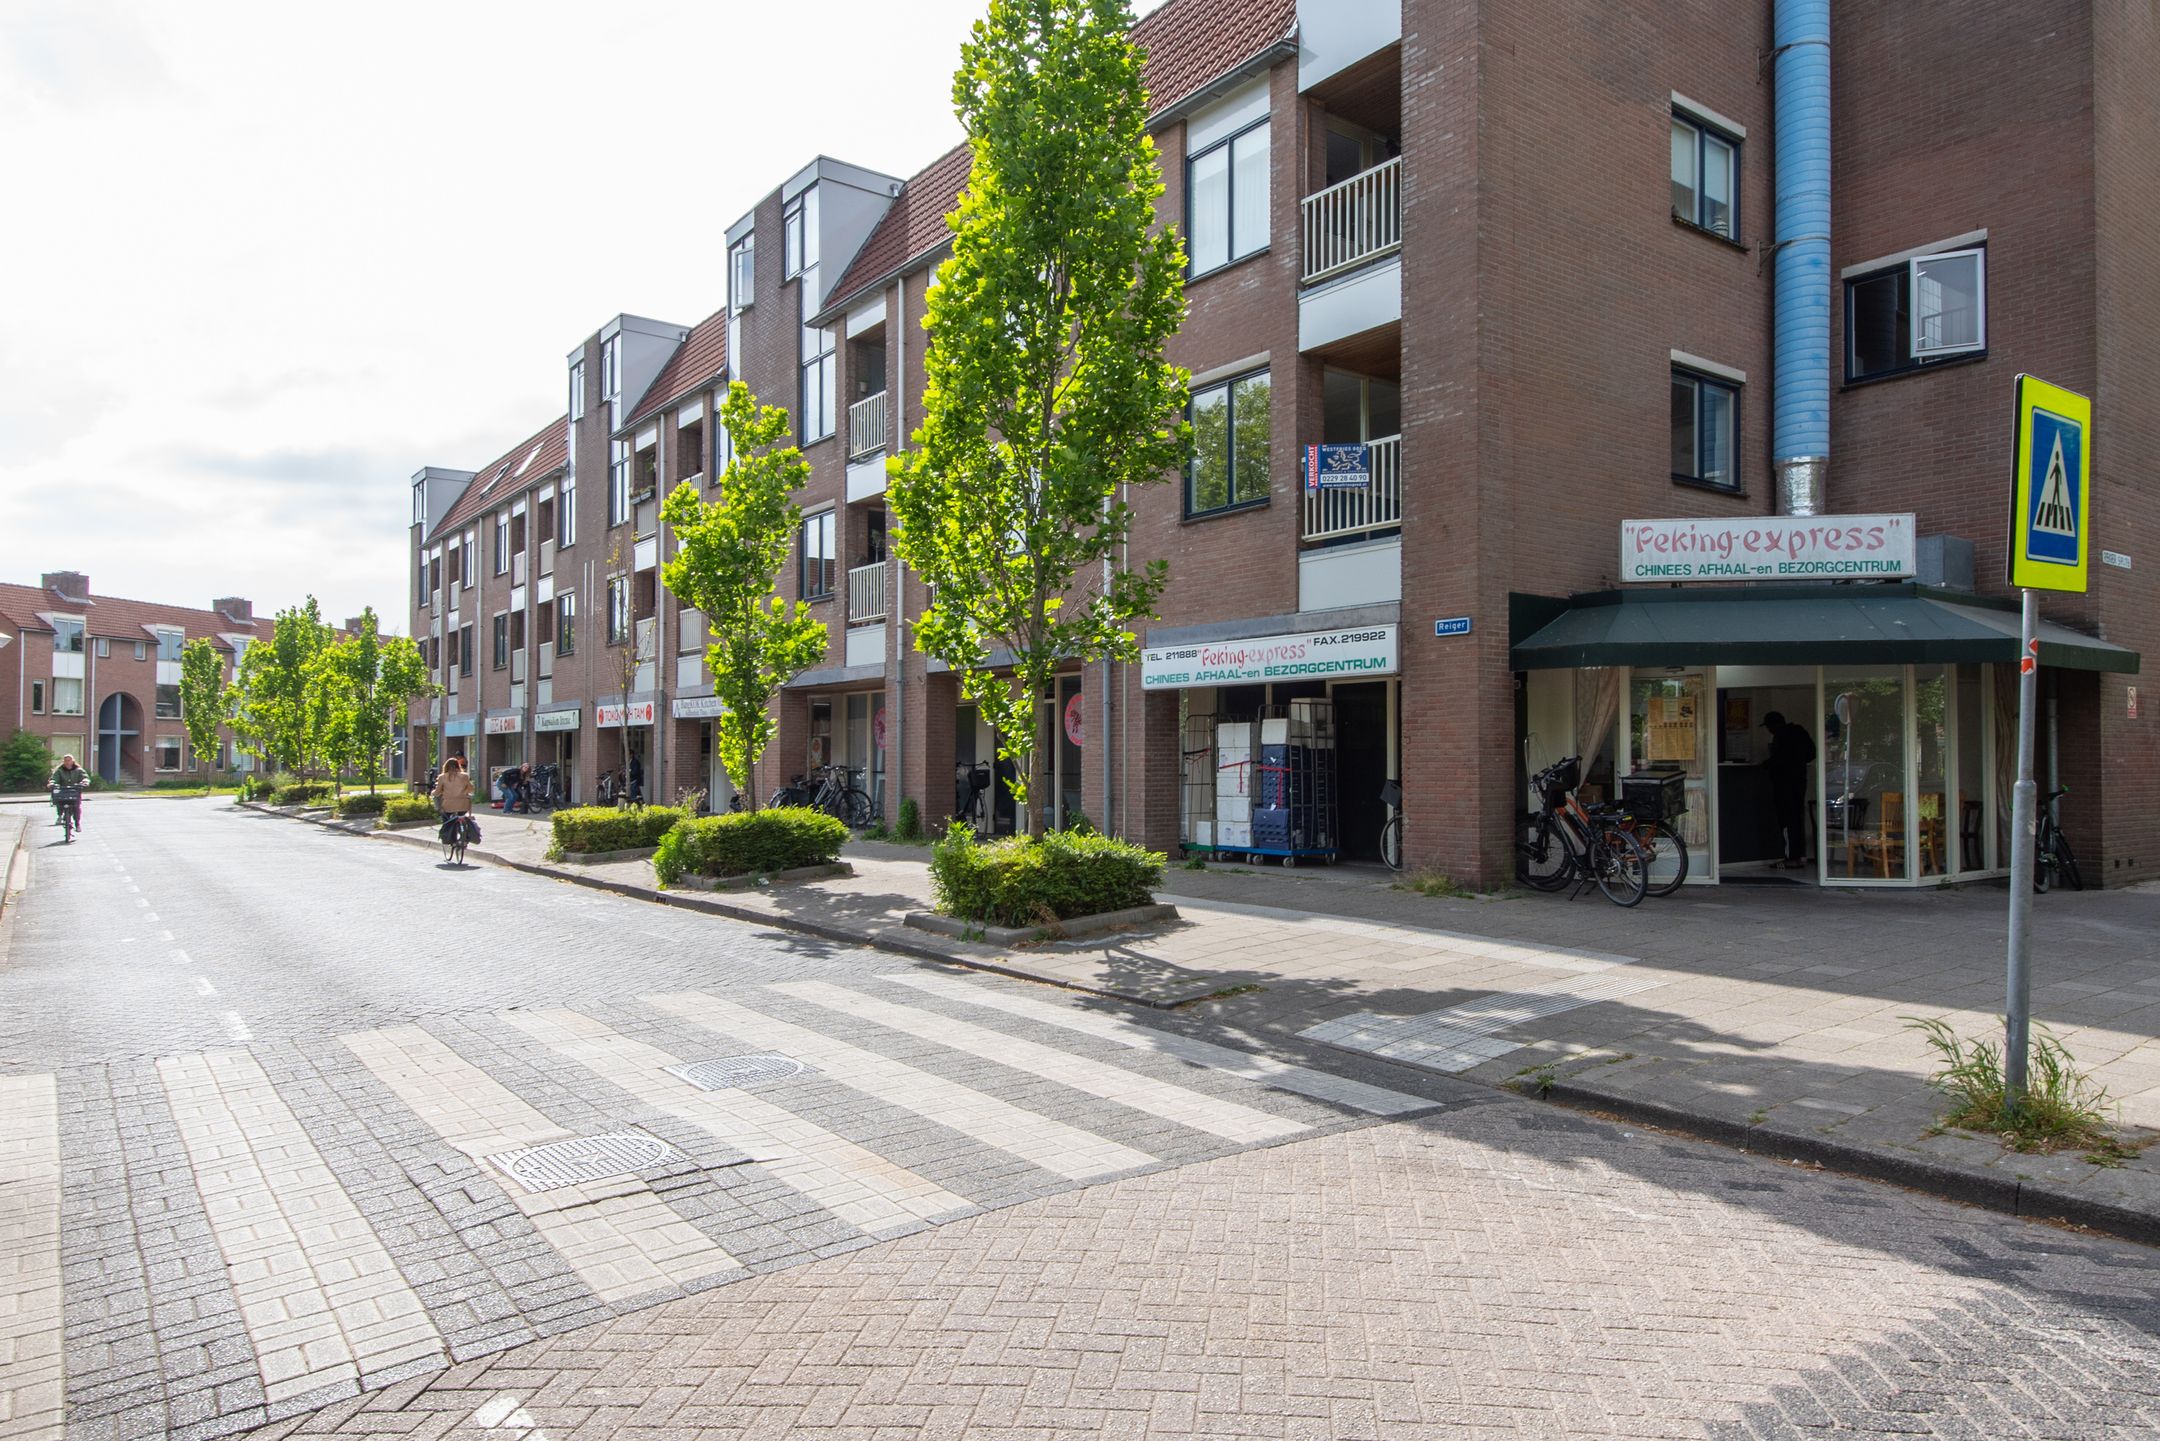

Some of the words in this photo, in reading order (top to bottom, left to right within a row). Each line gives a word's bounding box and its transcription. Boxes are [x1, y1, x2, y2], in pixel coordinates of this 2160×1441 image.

[1635, 564, 1692, 576] CHINEES
[1698, 562, 1773, 575] AFHAAL-en
[1778, 560, 1901, 574] BEZORGCENTRUM
[1438, 622, 1466, 631] Reiger
[1166, 650, 1198, 660] 211888
[1313, 631, 1386, 646] FAX.219922
[1145, 673, 1190, 685] CHINEES
[1195, 669, 1260, 681] AFHAAL-en
[1264, 657, 1387, 677] BEZORGCENTRUM
